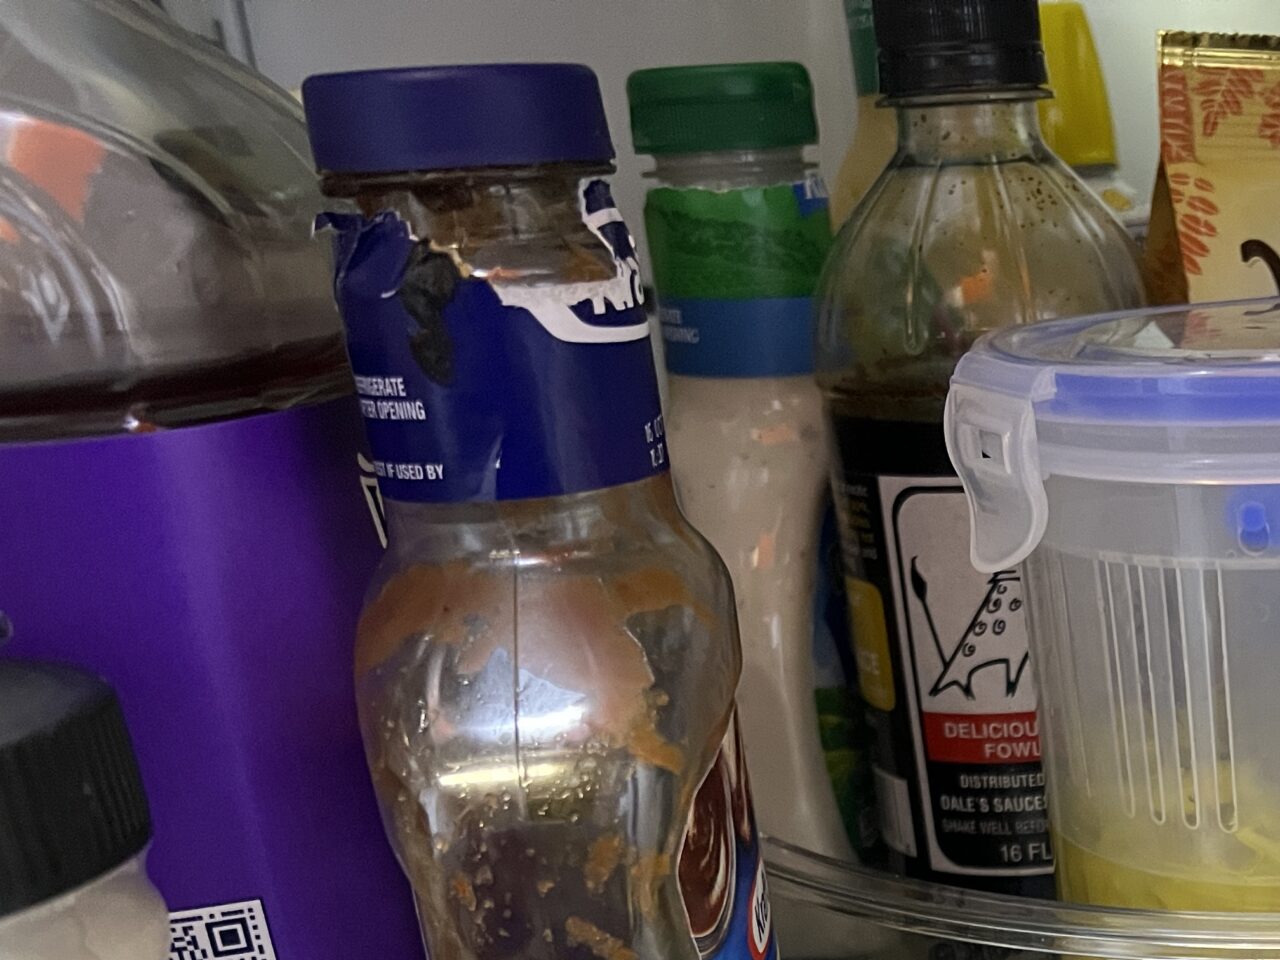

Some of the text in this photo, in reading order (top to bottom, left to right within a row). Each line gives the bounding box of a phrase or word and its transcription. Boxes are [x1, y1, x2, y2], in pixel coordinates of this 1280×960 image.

[377, 400, 427, 420] OPENING
[395, 464, 424, 480] USED
[425, 464, 444, 480] BY
[944, 722, 1041, 739] DELICIOU
[960, 773, 1046, 788] DISTRIBUTED
[940, 796, 989, 813] DALE'S
[980, 820, 1012, 835] WELL
[1015, 820, 1049, 835] BEFO
[1001, 843, 1053, 862] 16 FL
